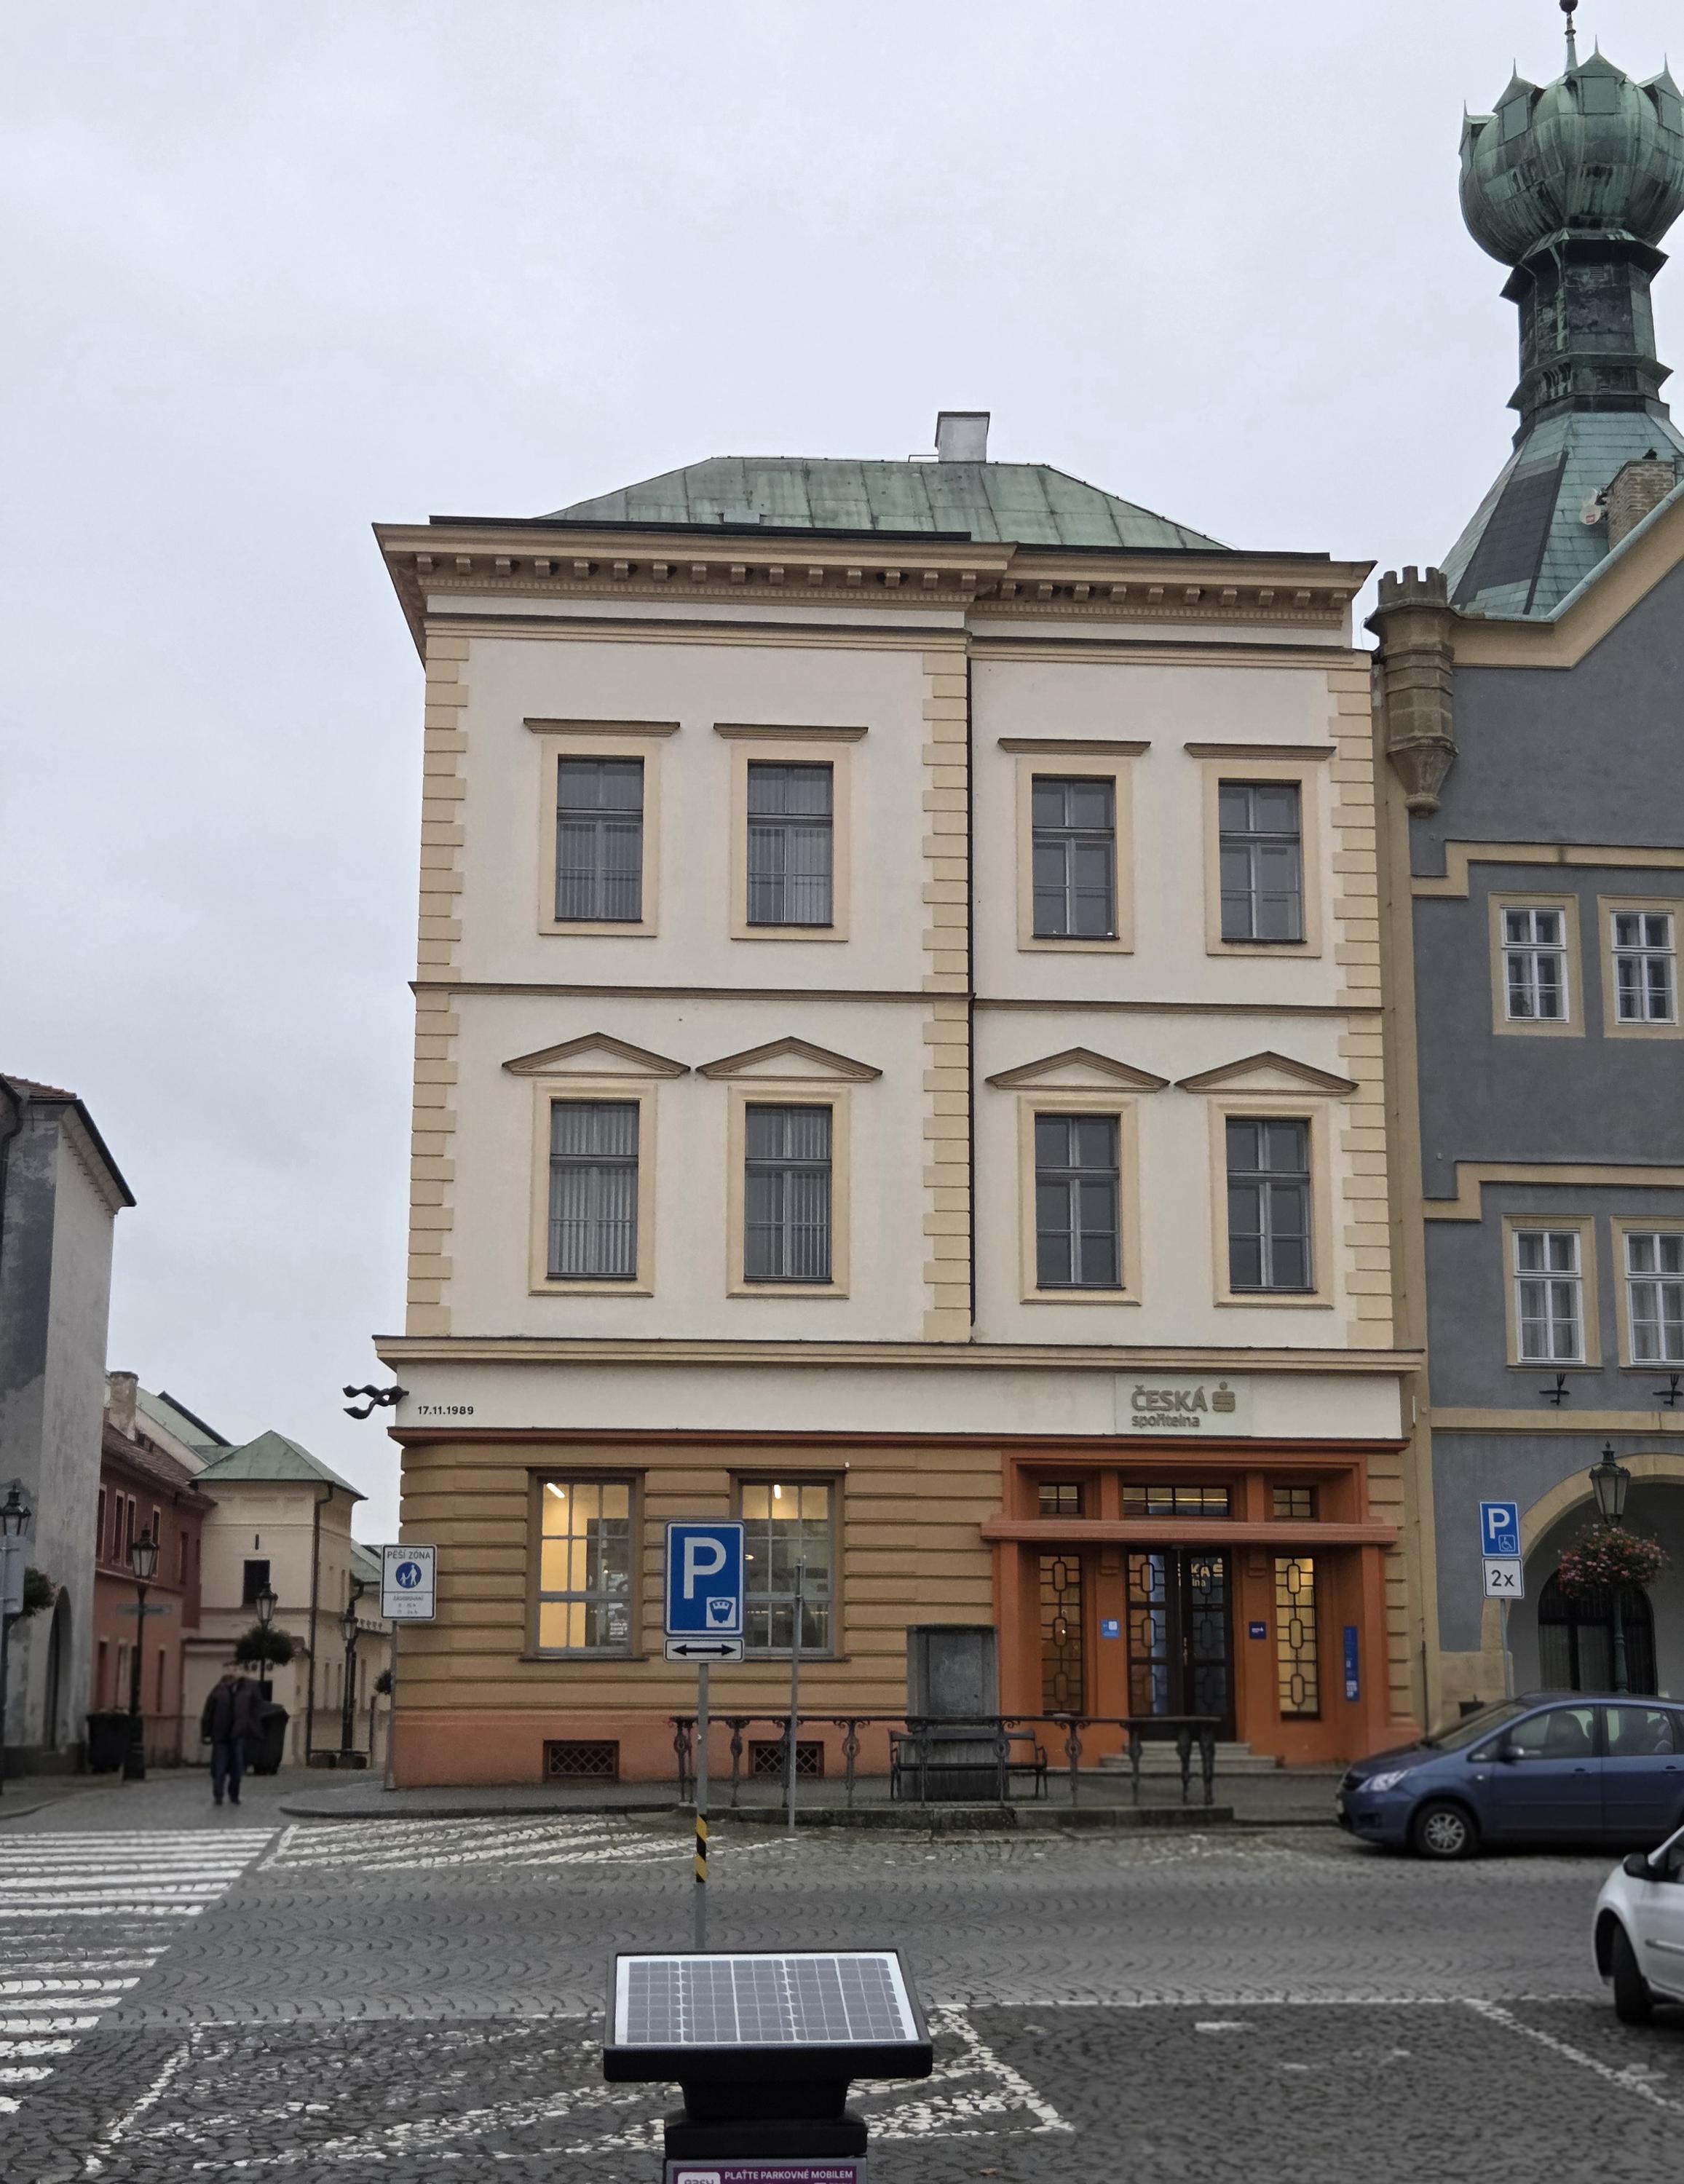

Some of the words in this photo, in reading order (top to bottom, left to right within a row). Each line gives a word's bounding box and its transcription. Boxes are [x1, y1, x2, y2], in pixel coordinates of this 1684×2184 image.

[1131, 1385, 1208, 1412] ČESKÁ
[418, 1406, 474, 1415] 17.11.1989
[1131, 1413, 1200, 1428] spořitelna
[1488, 1508, 1510, 1539] P
[387, 1549, 406, 1559] PĚŠÍ
[408, 1550, 431, 1559] ZÓNA
[684, 1537, 727, 1599] P
[1491, 1570, 1514, 1587] 2x
[724, 2169, 759, 2180] PLAŤTE
[761, 2169, 809, 2179] PARKOVNÉ
[811, 2170, 853, 2179] MOBILEM
